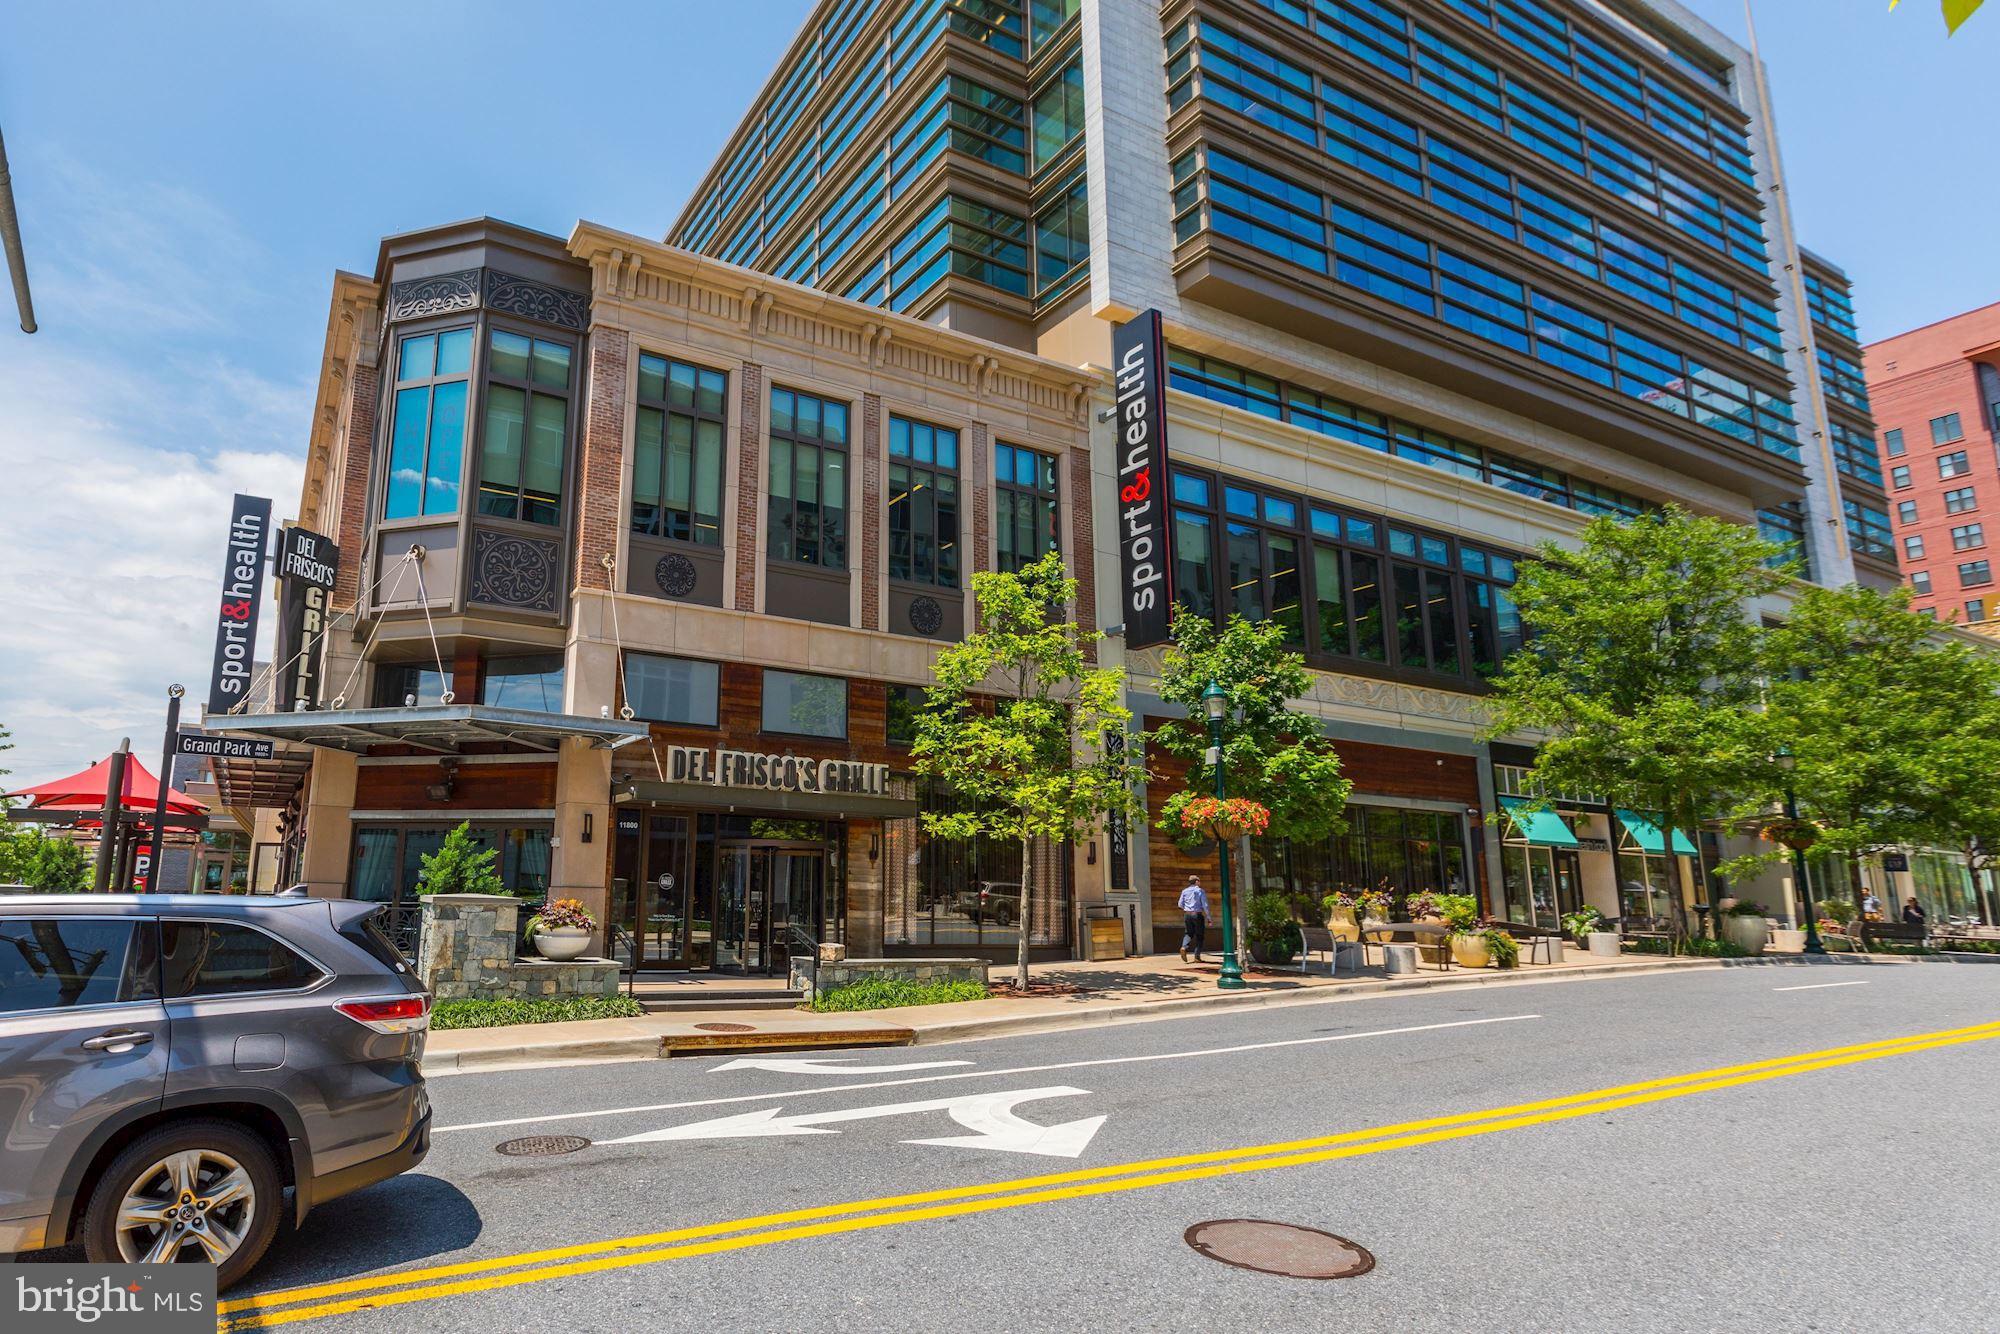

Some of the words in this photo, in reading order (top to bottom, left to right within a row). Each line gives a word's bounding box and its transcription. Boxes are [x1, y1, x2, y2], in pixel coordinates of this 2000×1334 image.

[1116, 342, 1162, 612] sport&health
[297, 535, 316, 560] DEL
[286, 553, 334, 587] FRISCO'S
[220, 514, 262, 694] sport&health
[183, 738, 221, 753] Grand
[224, 742, 251, 756] Park
[255, 743, 269, 752] Ave
[666, 745, 714, 784] DEL
[715, 749, 818, 793] FRISCO'S
[818, 759, 889, 798] GRILLE
[619, 821, 638, 829] 11800
